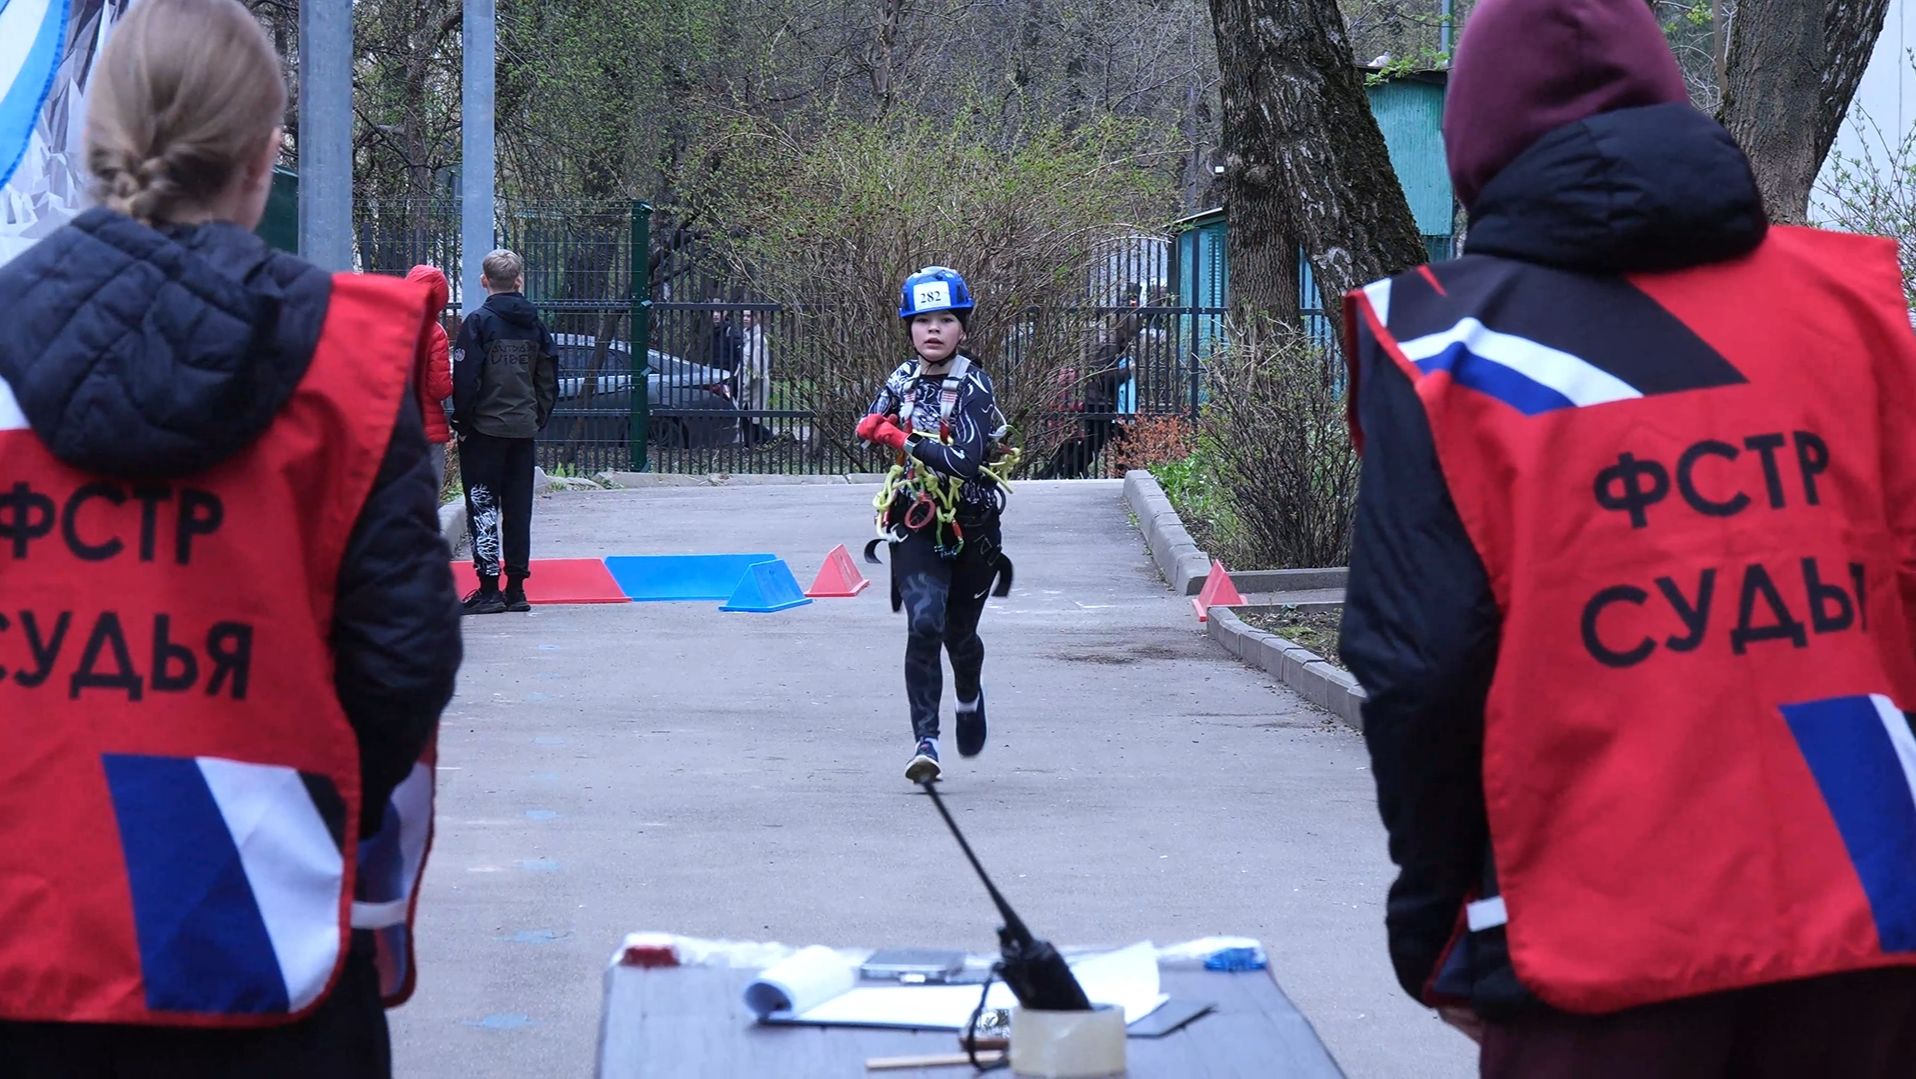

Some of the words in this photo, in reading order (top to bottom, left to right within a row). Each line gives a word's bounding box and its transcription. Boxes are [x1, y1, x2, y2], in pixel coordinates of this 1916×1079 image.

[920, 290, 942, 304] 282
[1593, 430, 1829, 529] ФСТР
[0, 481, 225, 566] ФСТР
[0, 611, 254, 701] УДЬЯ
